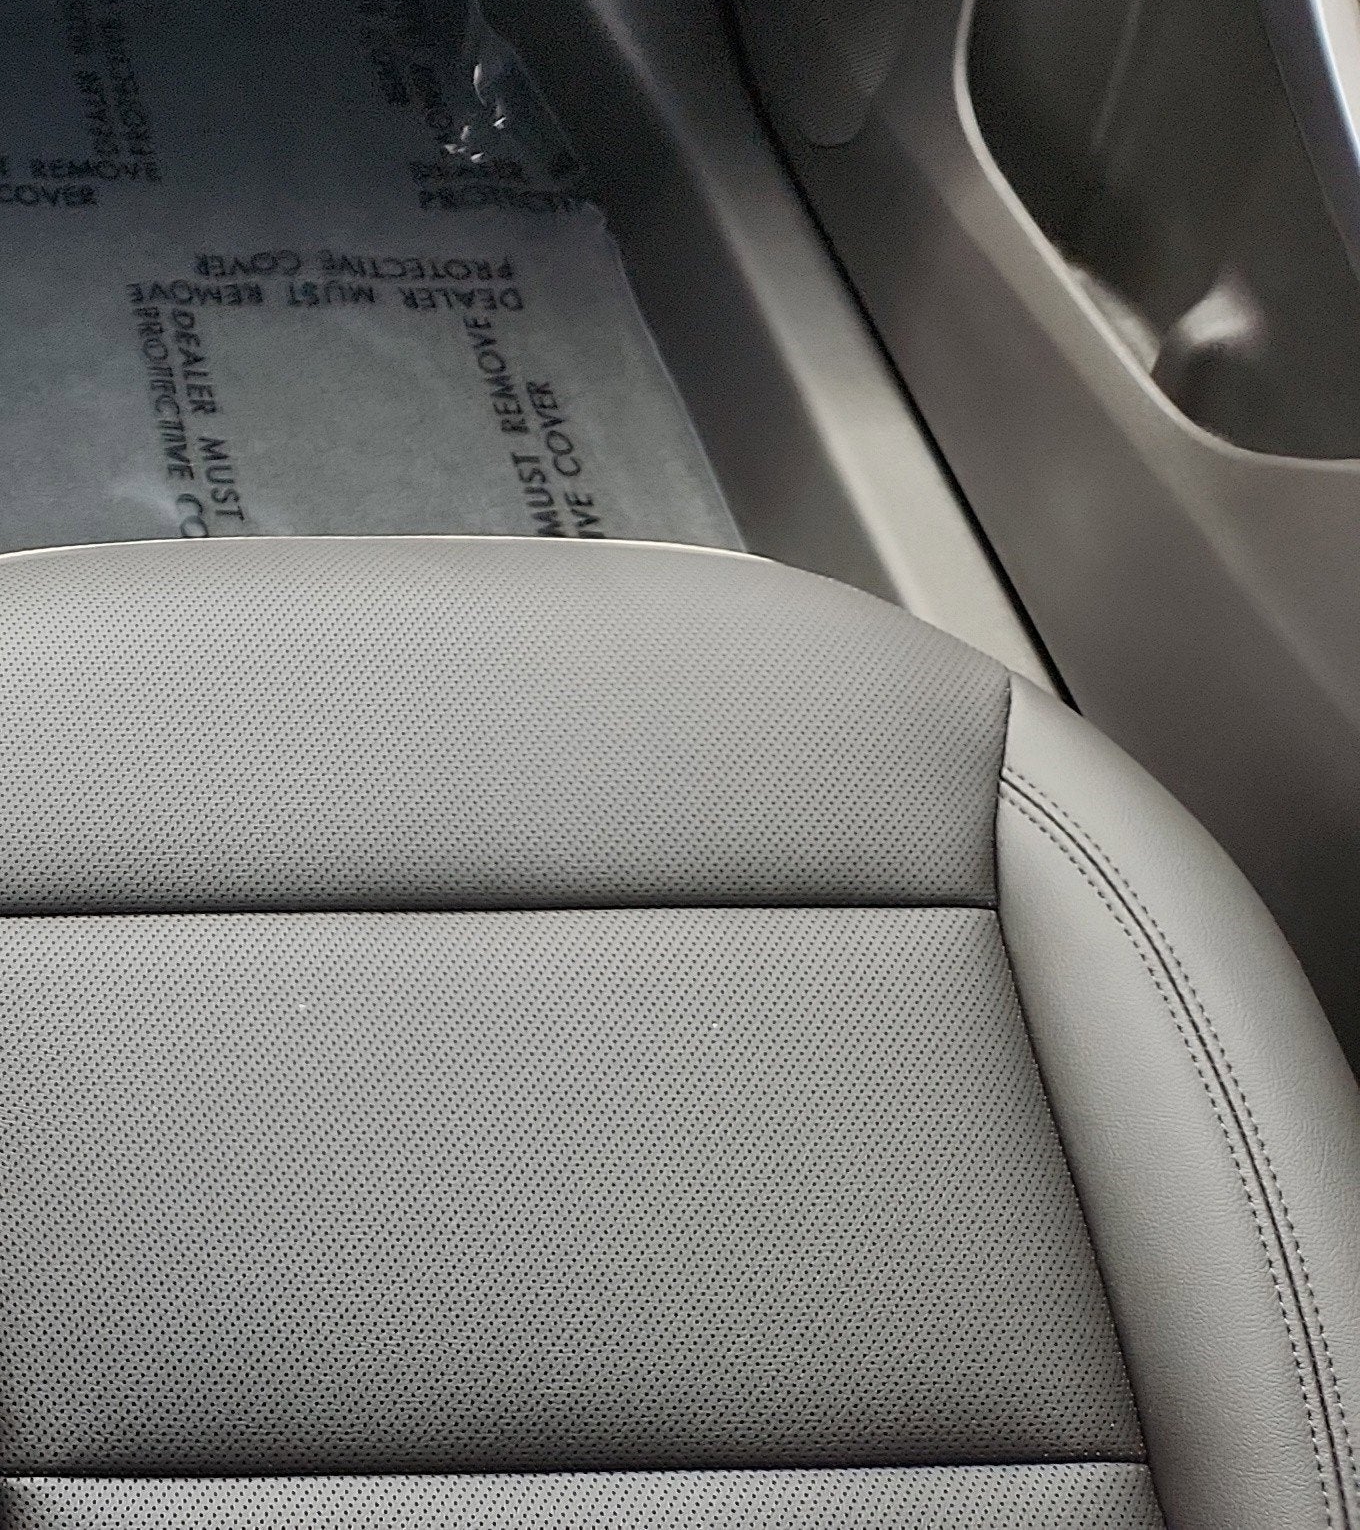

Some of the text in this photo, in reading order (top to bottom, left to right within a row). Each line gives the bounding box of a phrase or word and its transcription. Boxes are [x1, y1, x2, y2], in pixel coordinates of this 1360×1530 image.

[29, 157, 162, 185] REMOVE
[128, 279, 523, 312] DEALER MUST REMOVE
[195, 250, 516, 282] PROTECTIVE COVER
[132, 305, 194, 481] PROTECTIVE
[172, 308, 245, 522] DEALER MUST
[463, 316, 565, 538] MUST REMOVE
[523, 379, 582, 478] COVER
